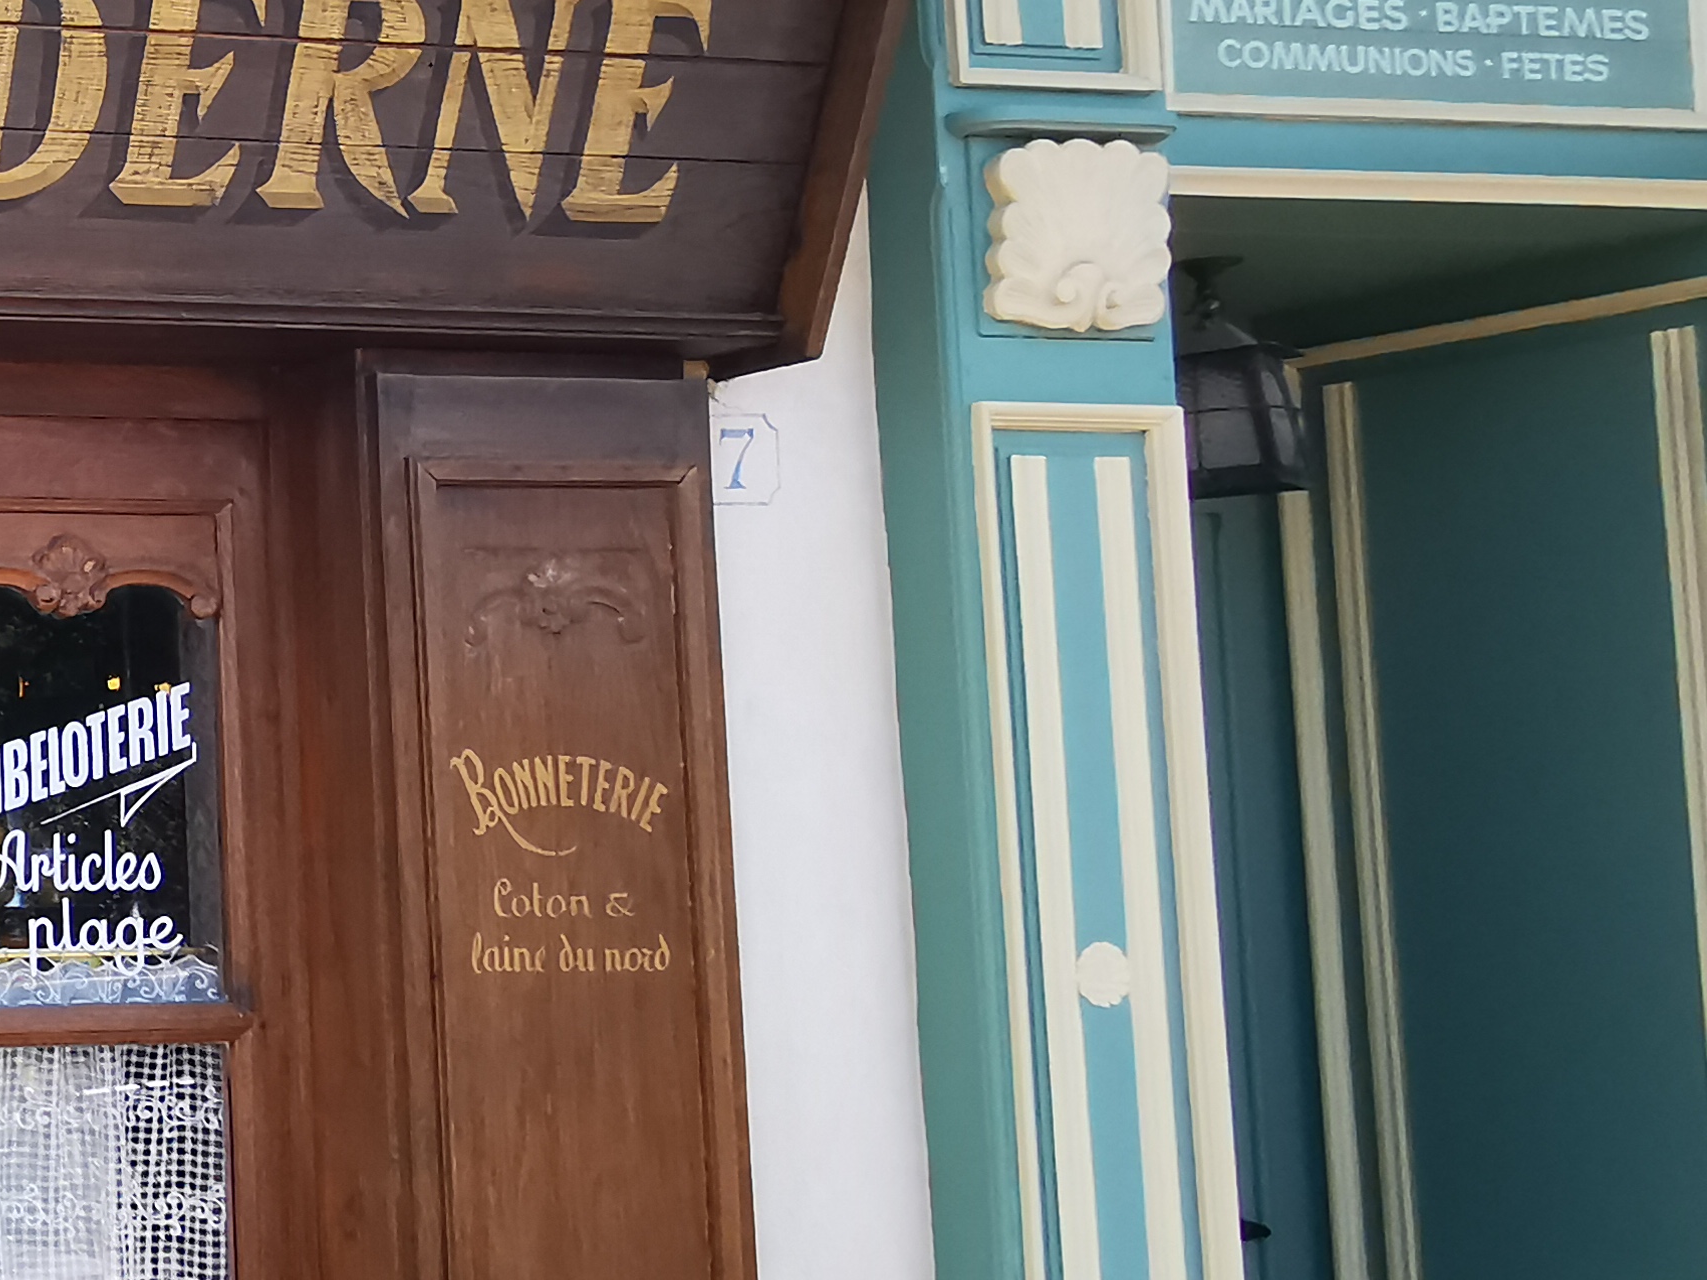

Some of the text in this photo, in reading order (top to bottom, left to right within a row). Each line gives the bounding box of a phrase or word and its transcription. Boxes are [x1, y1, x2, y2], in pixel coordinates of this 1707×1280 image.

[1435, 1, 1650, 41] BAPTEMES
[1218, 38, 1610, 82] COMMUNIONS FETES
[718, 427, 755, 489] 7
[450, 748, 668, 856] BONNETERIE
[493, 878, 635, 918] Coton &
[28, 897, 183, 977] plage
[559, 933, 595, 972] du
[604, 933, 670, 972] nord
